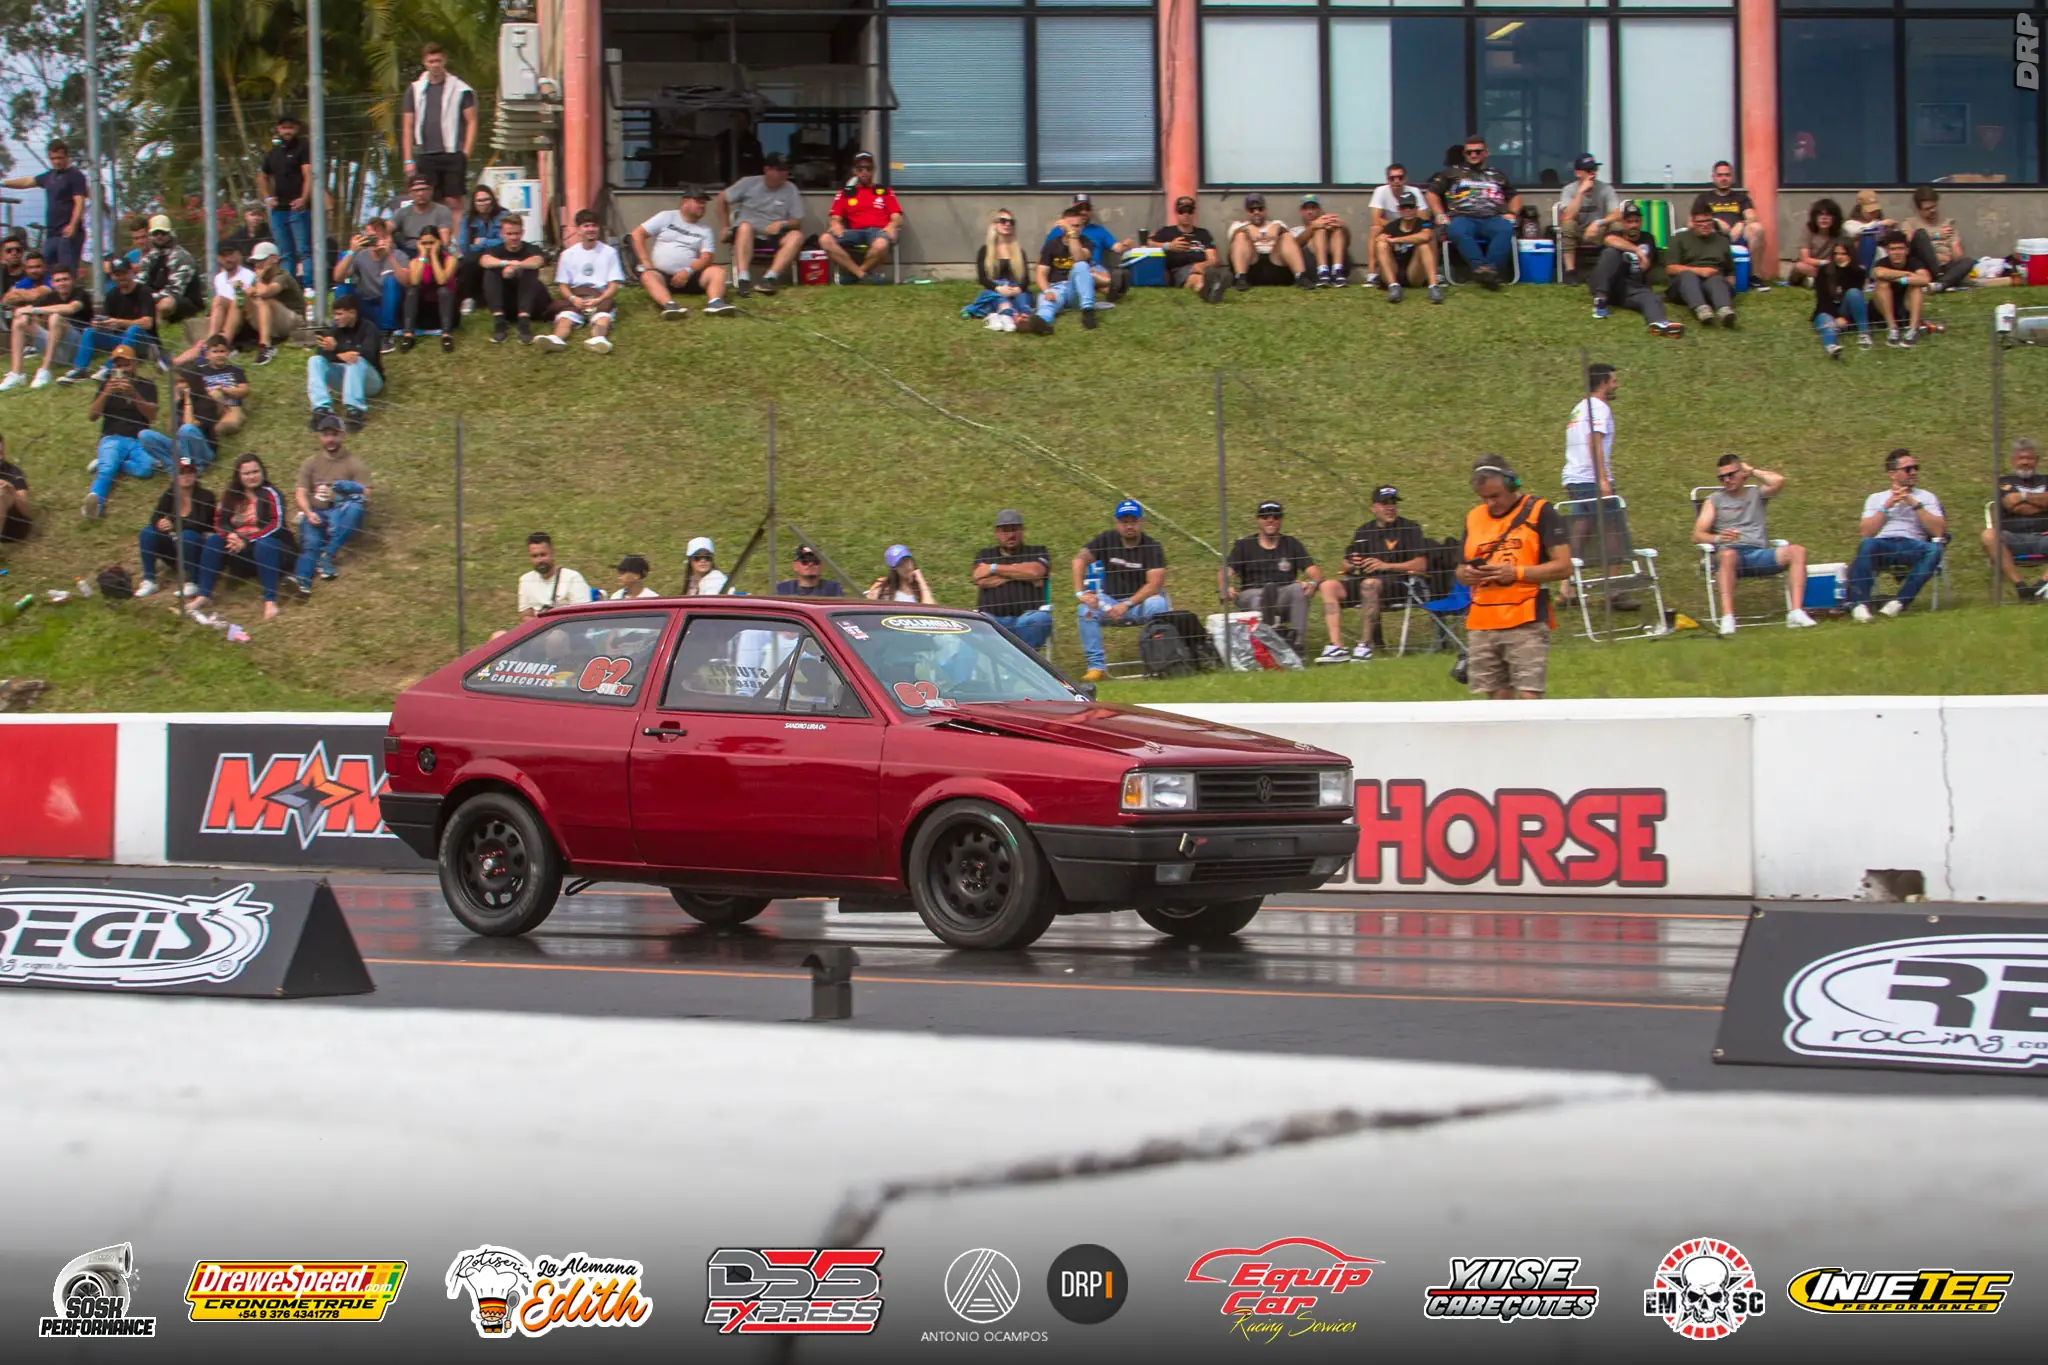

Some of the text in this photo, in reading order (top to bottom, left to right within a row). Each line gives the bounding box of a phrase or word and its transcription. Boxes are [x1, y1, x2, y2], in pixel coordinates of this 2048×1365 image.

[495, 660, 558, 677] STUMPF
[578, 657, 632, 692] 62
[893, 682, 939, 707] 62
